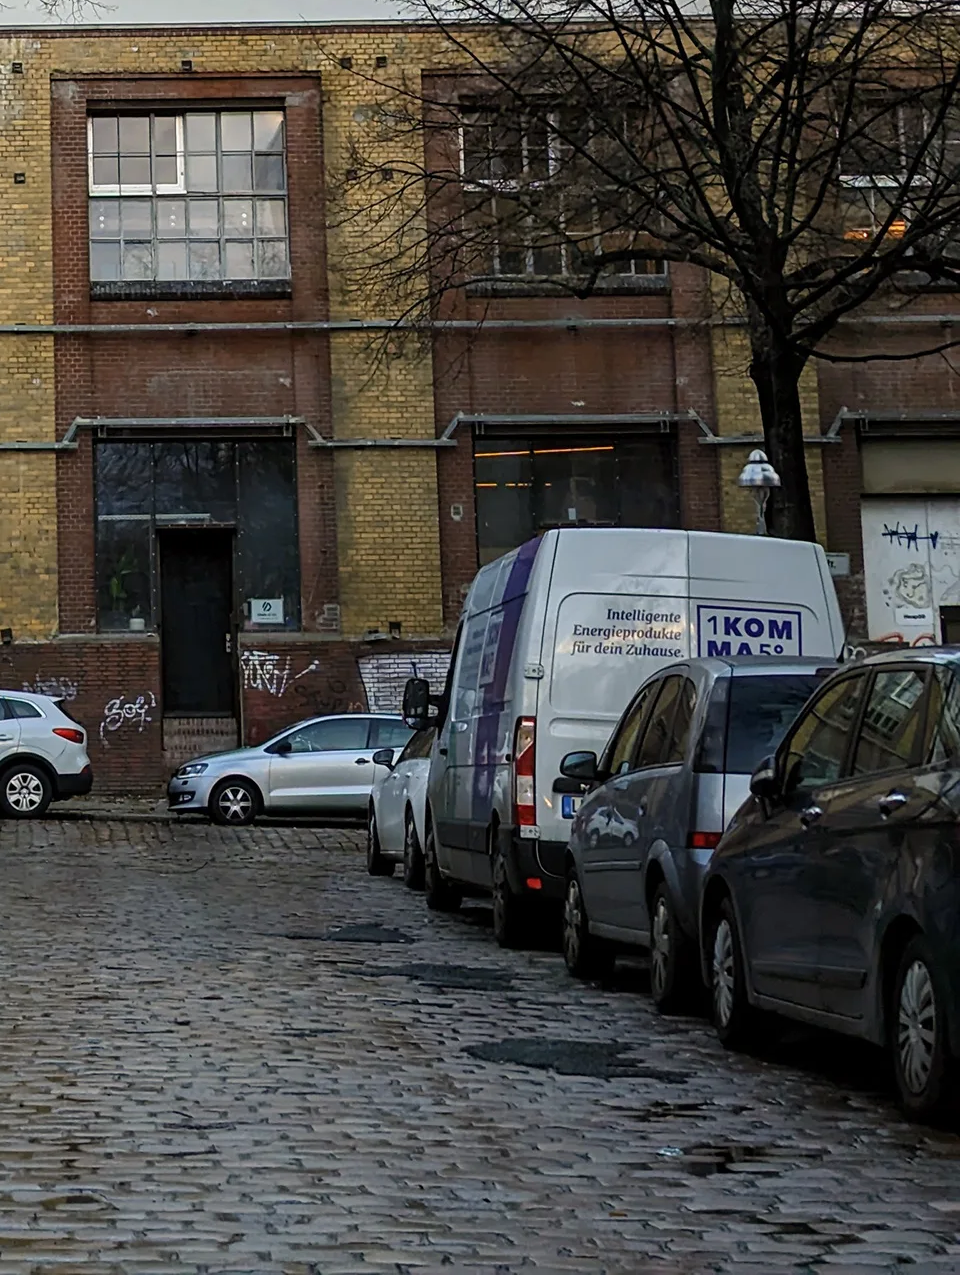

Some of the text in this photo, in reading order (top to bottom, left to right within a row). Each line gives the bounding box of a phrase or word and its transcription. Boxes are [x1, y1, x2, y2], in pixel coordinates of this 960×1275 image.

[606, 608, 682, 625] Intelligente
[572, 624, 682, 642] Energieprodukte
[707, 615, 793, 641] 1KOM
[570, 640, 685, 658] für dein Zuhause.
